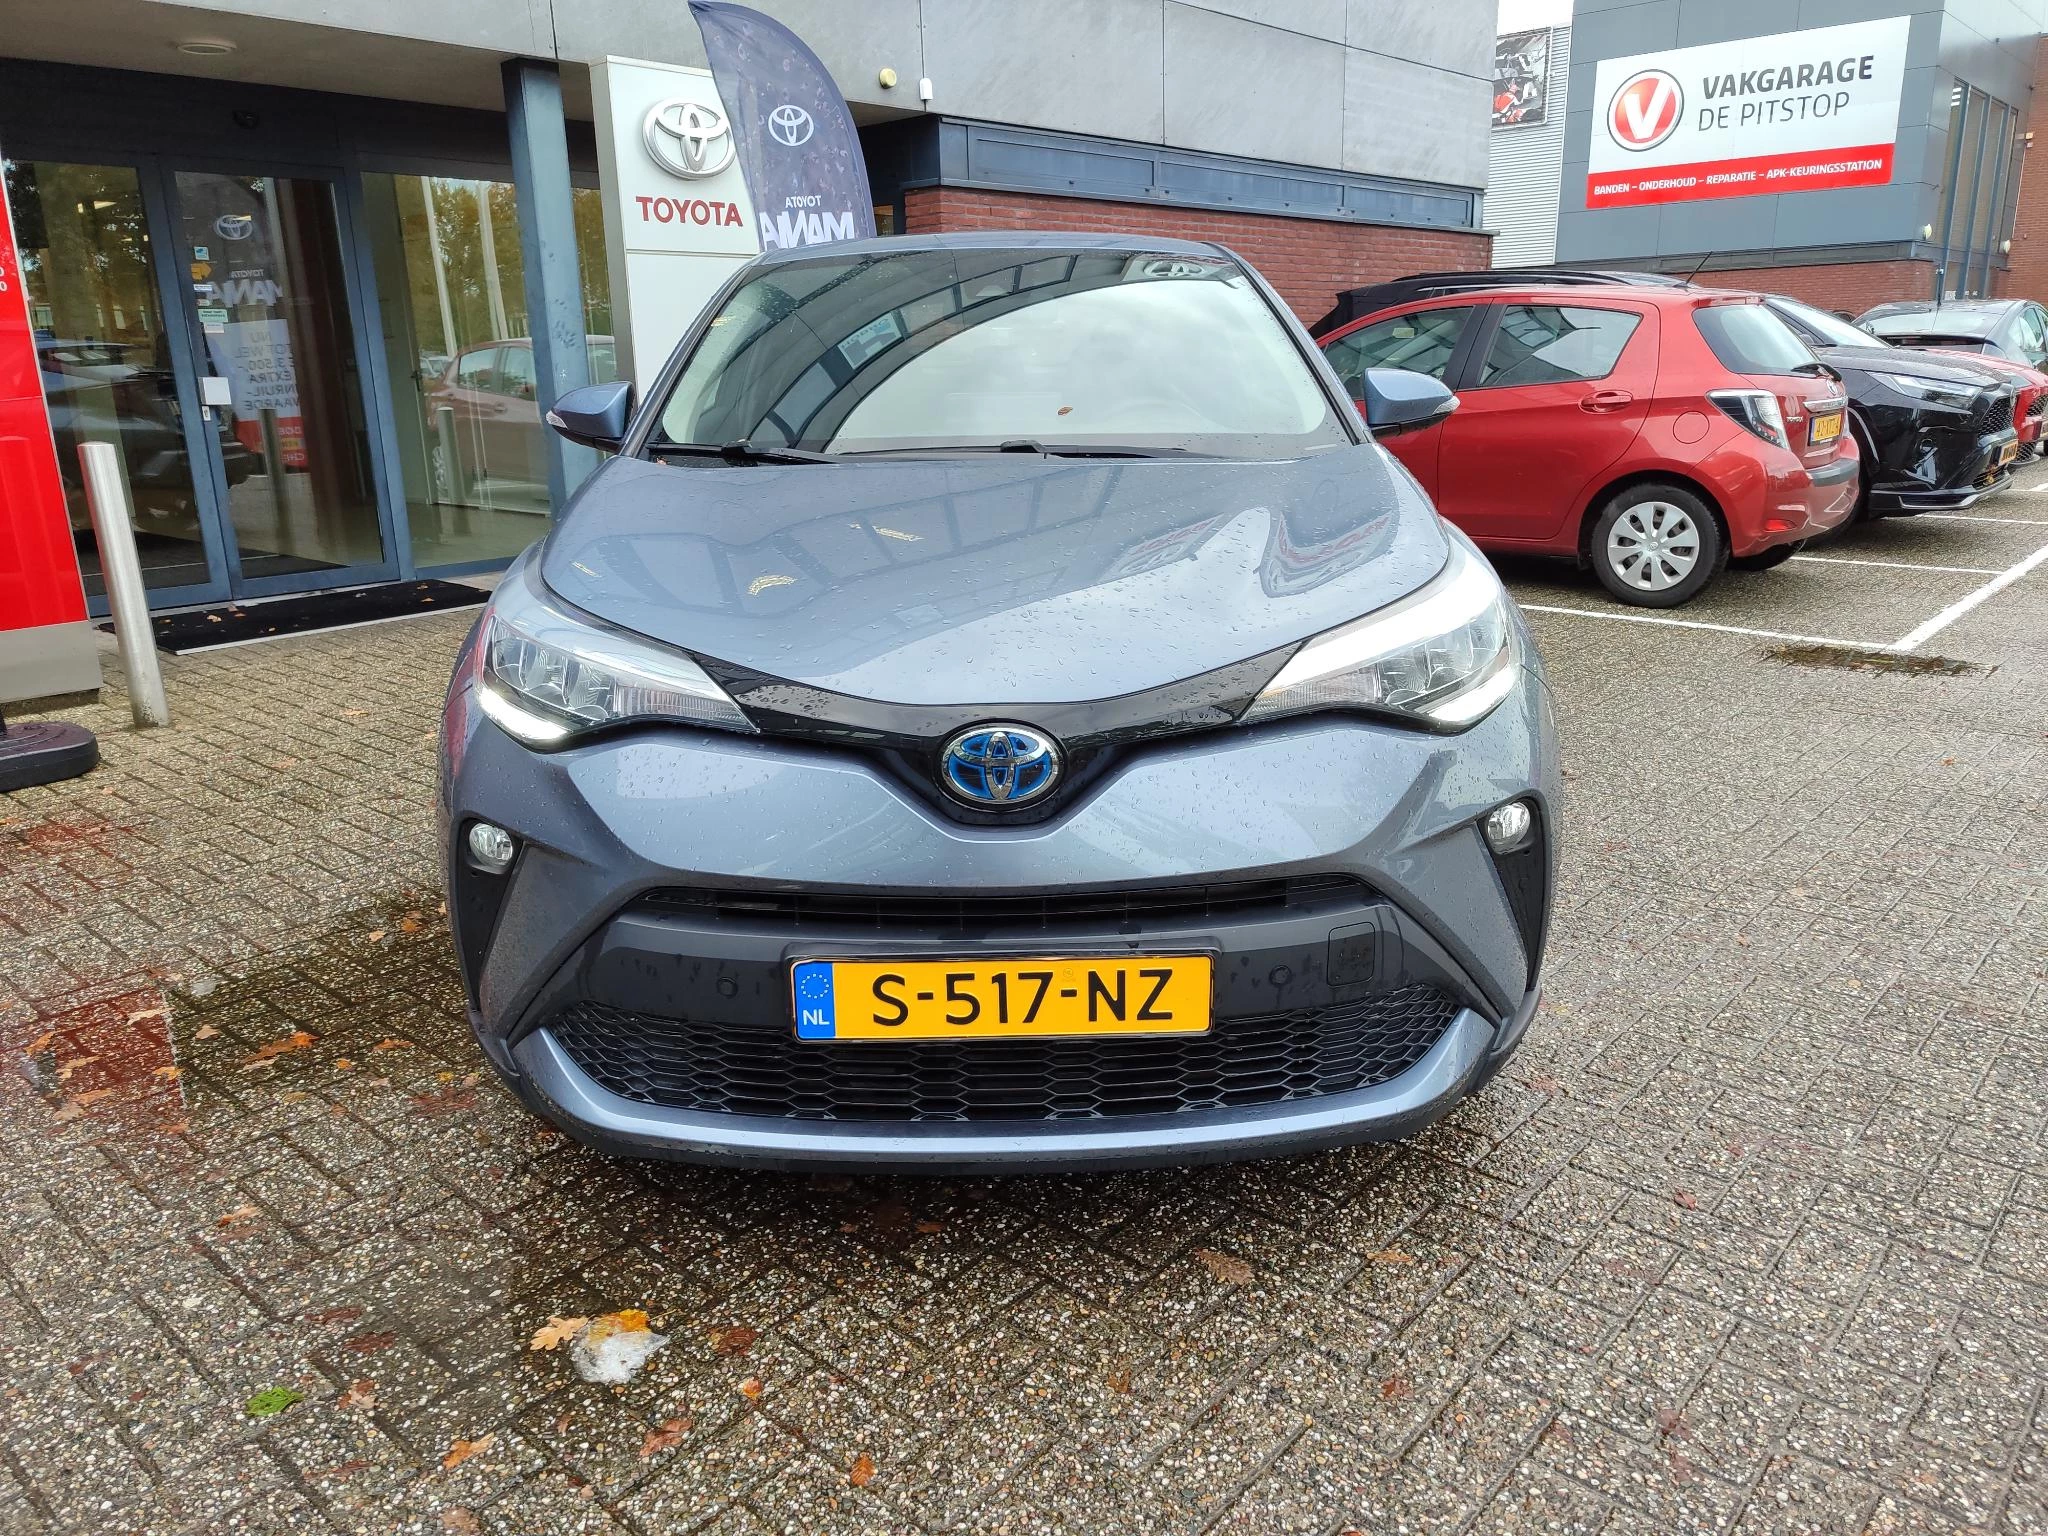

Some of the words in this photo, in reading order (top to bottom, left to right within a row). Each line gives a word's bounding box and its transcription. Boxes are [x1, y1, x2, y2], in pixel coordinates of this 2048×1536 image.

[1703, 55, 1874, 100] VAKGARAGE
[1698, 105, 1730, 132] DE
[1740, 91, 1850, 126] PITSTOP
[1594, 183, 1630, 195] BANDEN
[1638, 176, 1697, 191] ONDERHOUD
[1706, 171, 1757, 185] REPARATIE
[1766, 159, 1883, 179] APK-KEURINGSSTATION
[636, 196, 744, 227] TOYOTA
[872, 968, 1174, 1027] S-517-NZ
[802, 1009, 830, 1026] NL
